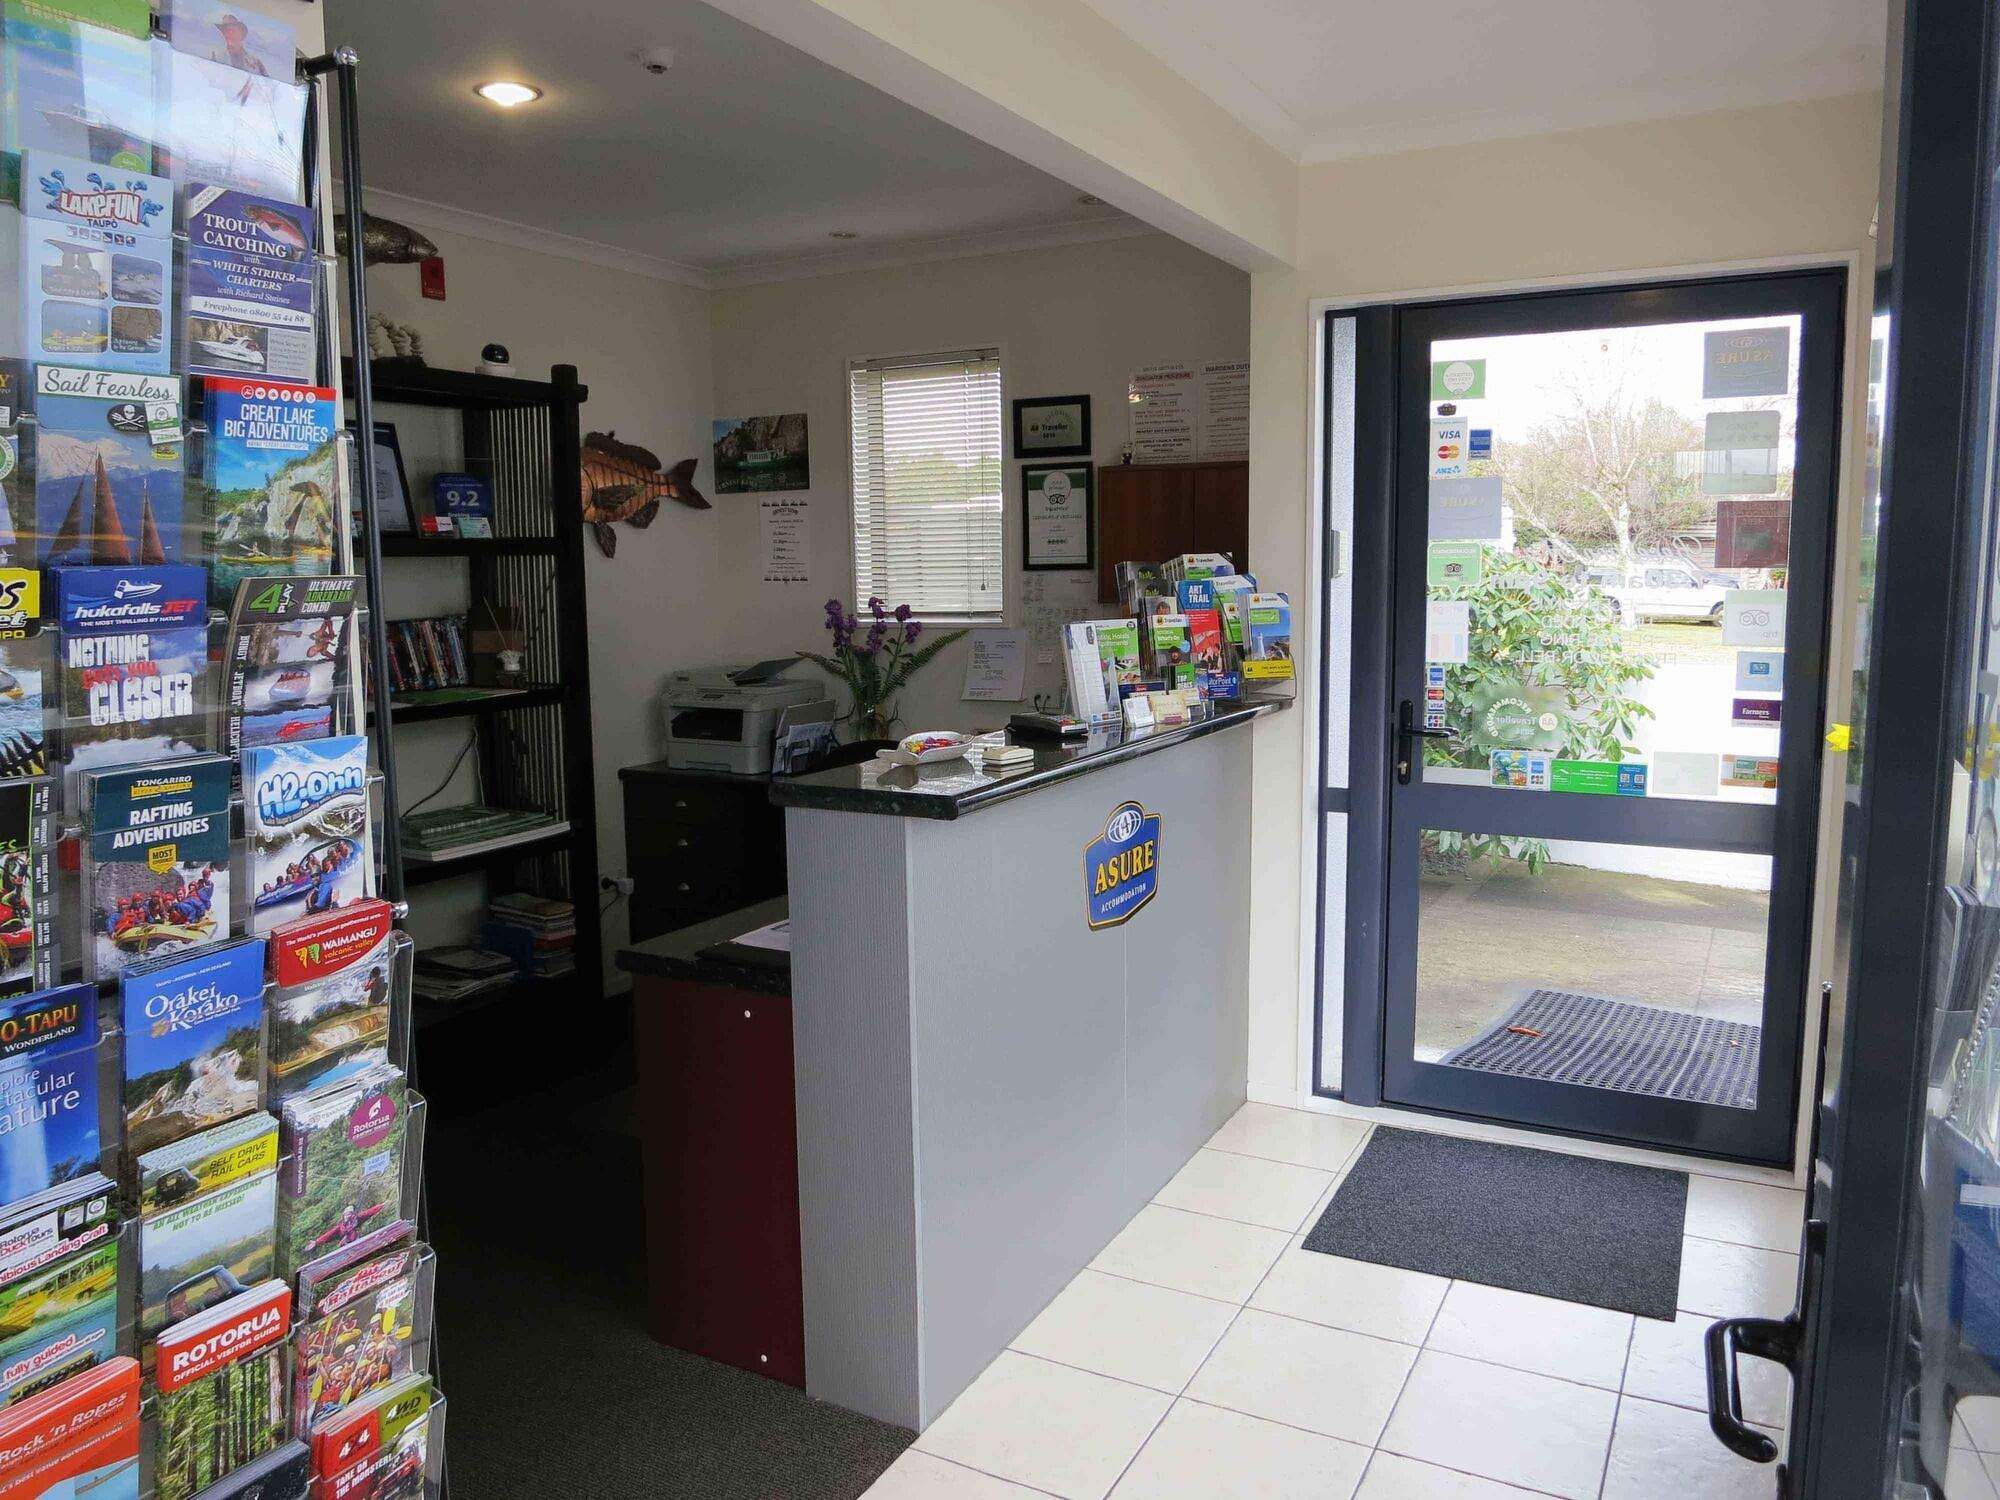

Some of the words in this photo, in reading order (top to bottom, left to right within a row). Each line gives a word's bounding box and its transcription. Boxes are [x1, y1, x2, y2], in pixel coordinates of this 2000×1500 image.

[203, 213, 259, 236] TROUT
[203, 230, 288, 258] CATCHING
[212, 260, 250, 275] WHITE
[250, 265, 297, 283] STRIKER
[226, 274, 282, 291] CHARTERS
[217, 286, 234, 296] with
[235, 288, 264, 300] Richard
[203, 300, 248, 316] Freephone
[249, 309, 271, 319] 0800
[44, 368, 91, 394] Sail
[96, 373, 174, 401] Fearless
[241, 403, 282, 422] GREAT
[284, 406, 316, 426] LAKE
[224, 419, 245, 437] BIG
[248, 421, 329, 443] ADVENTURES
[1438, 430, 1461, 439] VISA
[446, 490, 480, 507] 9.2
[308, 580, 354, 591] ULTIMATE
[1188, 585, 1203, 594] ART
[74, 602, 163, 620] hukafalls
[160, 600, 198, 614] JET
[251, 583, 284, 614] 4
[277, 583, 295, 613] PLAY
[301, 601, 331, 613] COMBO
[1189, 594, 1210, 603] TRAIL
[68, 633, 150, 668] NOTHING
[235, 635, 250, 661] BUNGY
[89, 672, 193, 727] CLOSER
[231, 671, 245, 707] JETBOAT
[1742, 707, 1770, 716] Farmers
[136, 775, 192, 787] TONGARIRO
[129, 801, 193, 826] RAFTING
[112, 817, 210, 849] ADVENTURES
[152, 849, 173, 860] MOST
[1094, 840, 1155, 895] ASURE
[1101, 882, 1147, 913] ACCOMMODATION
[341, 915, 370, 930] geothermal
[322, 926, 378, 951] WAIMANGU
[324, 945, 355, 960] volcanic
[355, 938, 376, 952] valley
[145, 981, 217, 1019] Orakei
[170, 993, 240, 1033] Korako
[4, 1025, 76, 1054] WONDERLAND
[352, 1114, 391, 1135] Rotorua
[210, 1152, 237, 1171] SELF
[237, 1139, 268, 1157] DRIVE
[211, 1165, 235, 1180] RAIL
[237, 1150, 265, 1169] CARS
[153, 1220, 167, 1231] AN
[167, 1211, 181, 1225] ALL
[220, 1179, 263, 1204] EXPERIENCE
[172, 1218, 189, 1232] NOT
[190, 1212, 202, 1223] TO
[0, 1242, 27, 1257] Duck
[27, 1227, 54, 1244] Tours
[38, 1237, 82, 1264] Landing
[80, 1222, 108, 1243] Craft
[173, 1306, 281, 1372] ROTORUA
[6, 1354, 31, 1382] fully
[33, 1333, 76, 1367] guided
[172, 1357, 216, 1383] OFFICIAL
[216, 1338, 252, 1361] VISITOR
[253, 1323, 281, 1342] GUIDE
[0, 1434, 45, 1465] Rock
[50, 1423, 67, 1437] 'n
[71, 1391, 129, 1428] Ropes
[336, 1483, 350, 1499] THE
